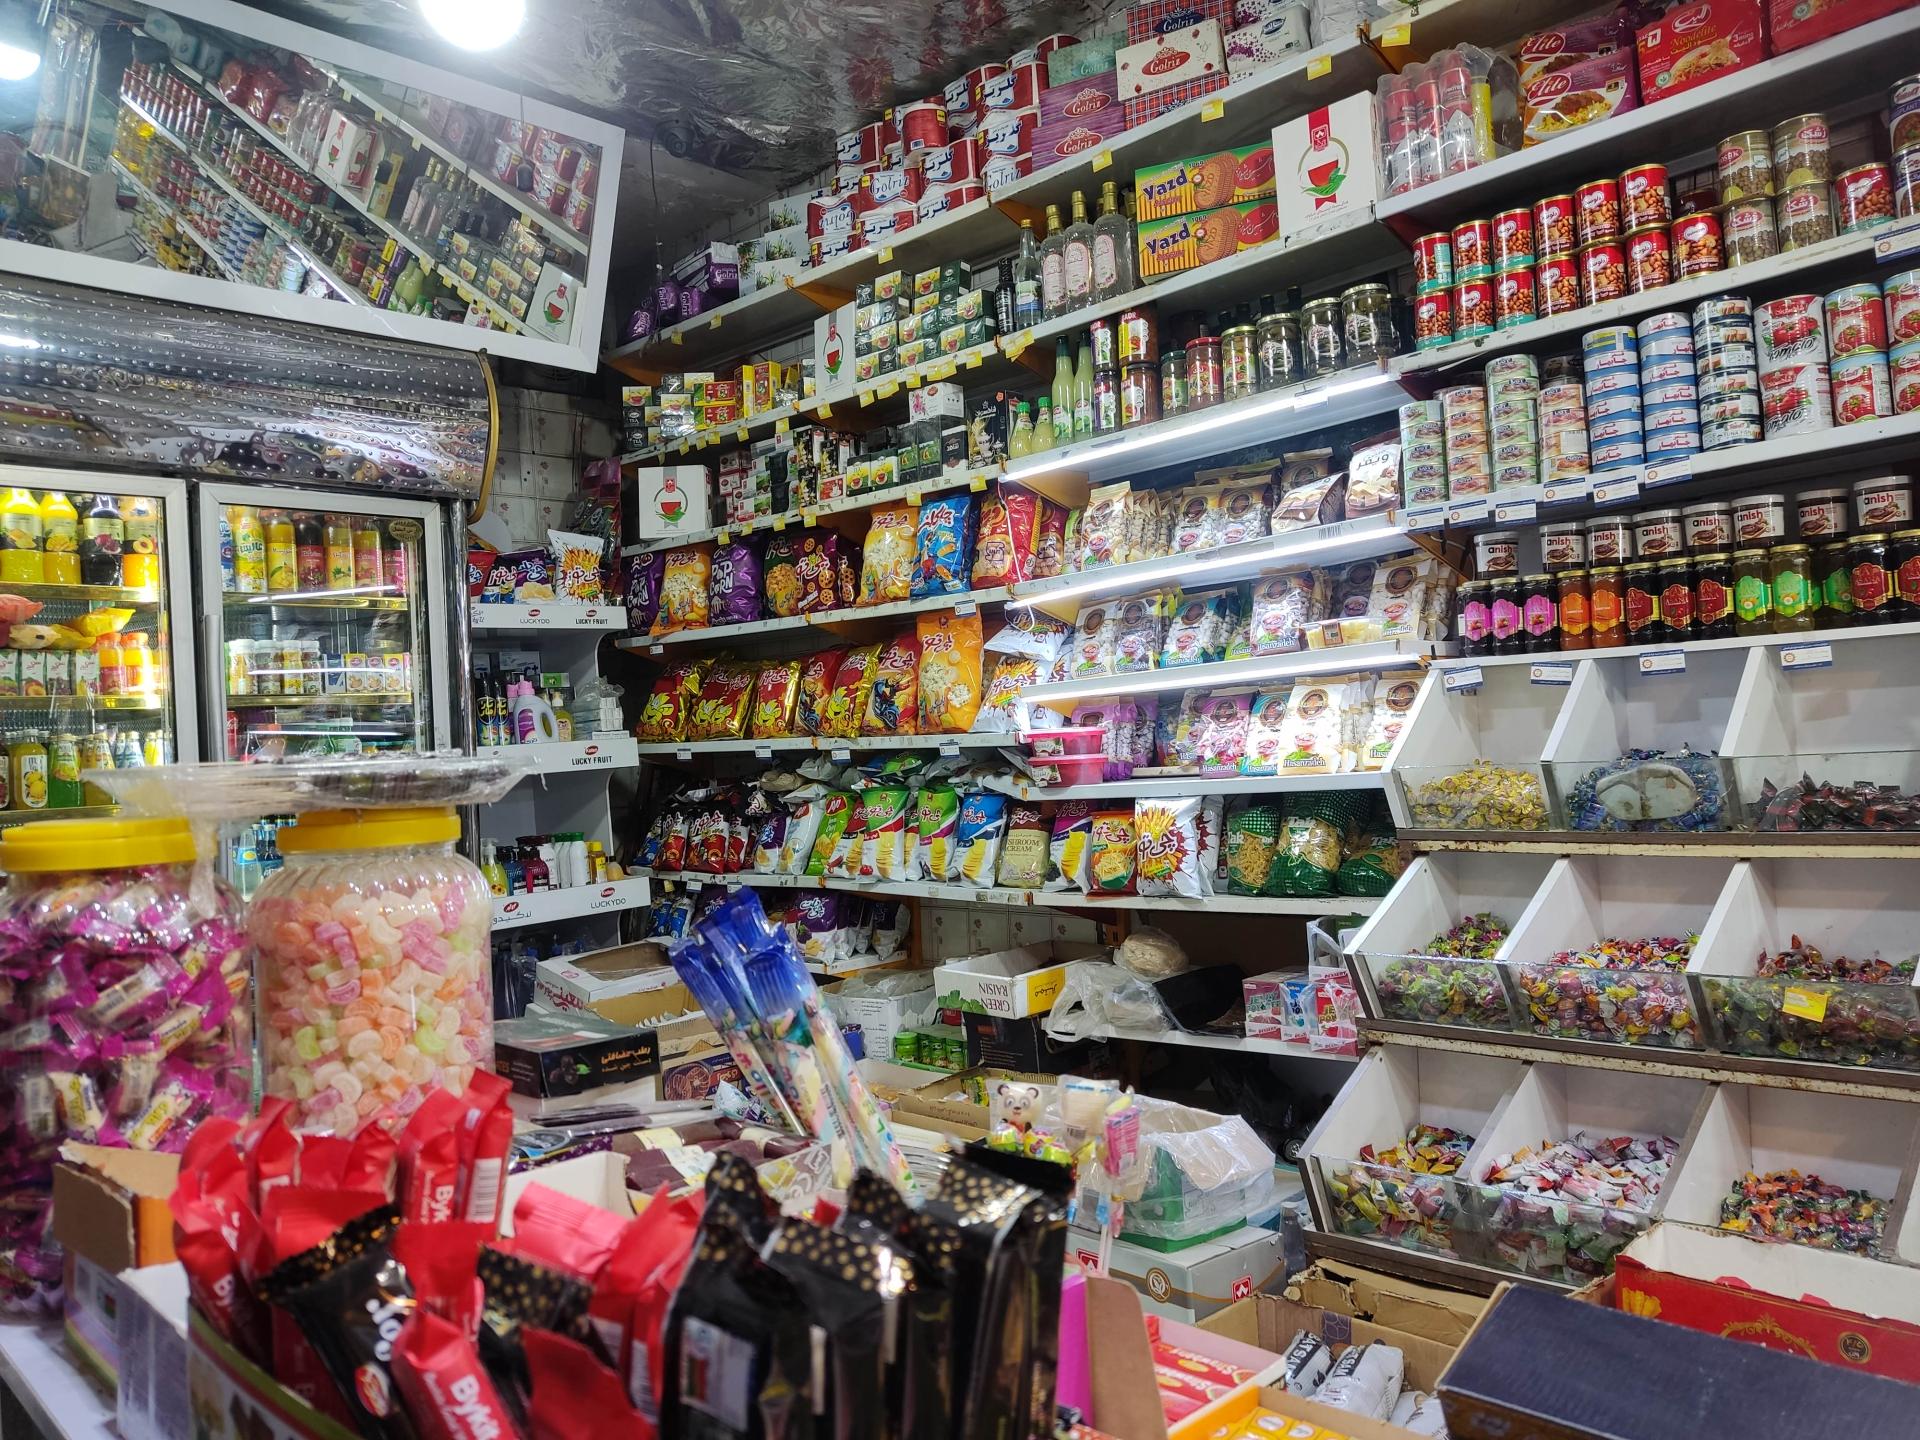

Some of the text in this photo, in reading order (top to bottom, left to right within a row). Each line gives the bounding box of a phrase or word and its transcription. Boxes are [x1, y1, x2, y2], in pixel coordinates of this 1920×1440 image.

[1150, 55, 1181, 74] Golriz
[1072, 97, 1101, 114] Golriz
[1063, 135, 1093, 154] Golriz
[870, 176, 908, 197] Golriz
[1143, 169, 1188, 200] Yazd
[1146, 222, 1190, 254] Yazd
[1864, 492, 1894, 505] anish
[1737, 510, 1763, 522] anish
[1800, 506, 1825, 518] anish
[1692, 516, 1720, 527] anish
[1592, 531, 1616, 542] anish
[1642, 525, 1669, 537] anish
[1546, 536, 1571, 546] anish
[1488, 544, 1513, 554] anish
[1257, 638, 1296, 652] Hasanzadeh
[572, 755, 612, 766] LUCKY FRUIT
[1283, 756, 1326, 768] Hasanzadeh
[1202, 763, 1237, 773] Hasanzadeh
[590, 898, 626, 909] LUCKYDO
[978, 982, 1009, 997] RAISIN
[980, 997, 1010, 1013] GREEN
